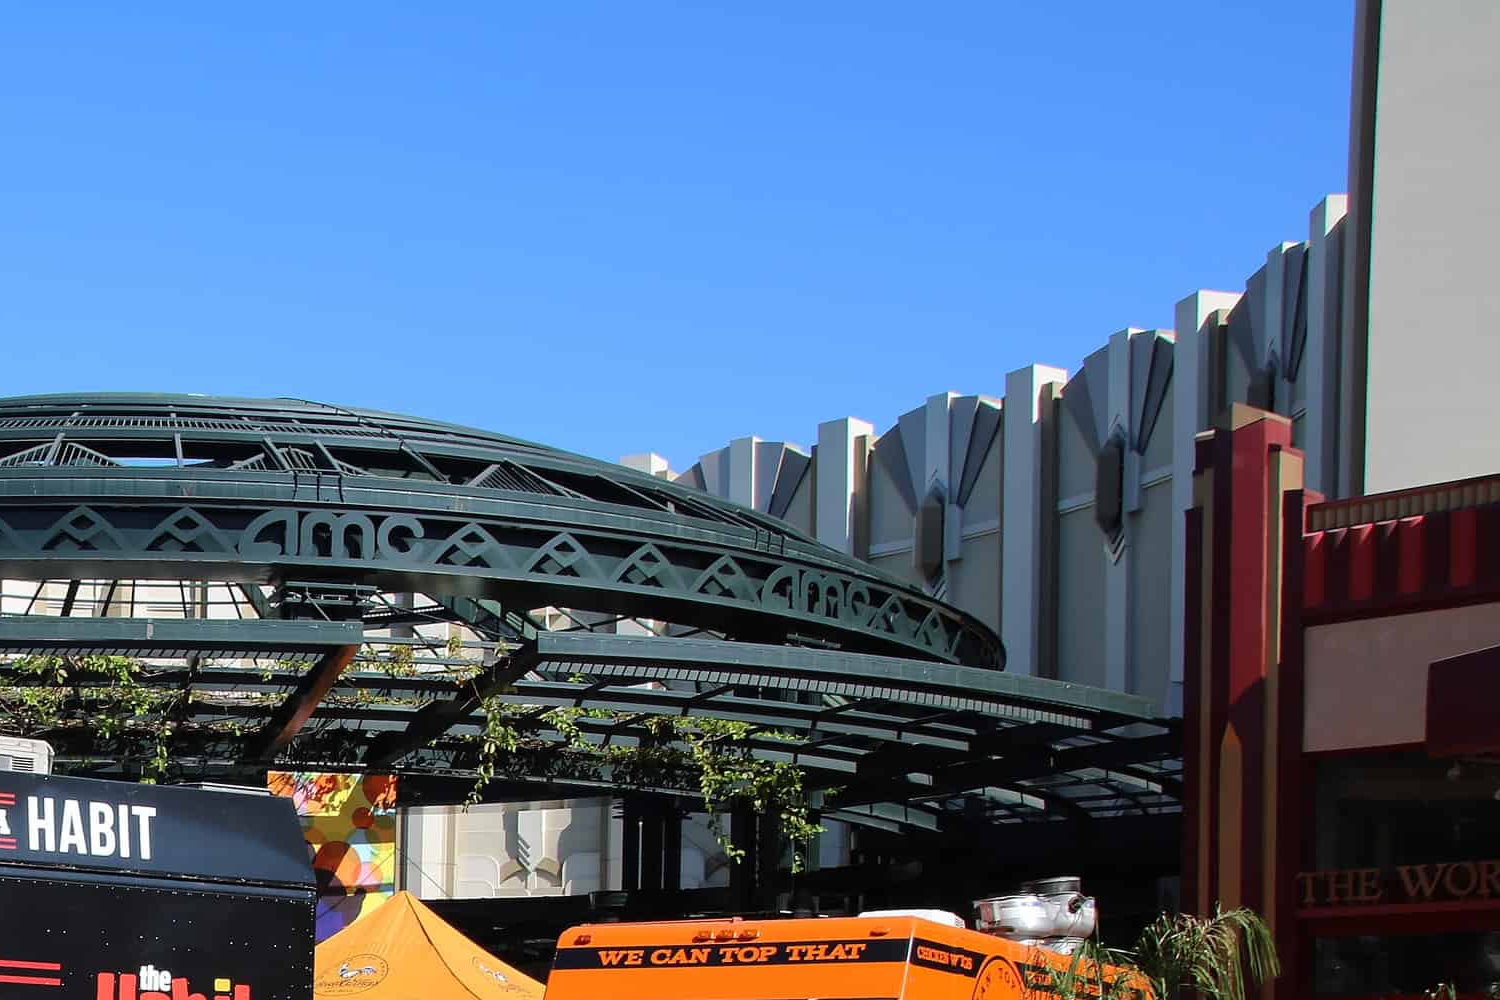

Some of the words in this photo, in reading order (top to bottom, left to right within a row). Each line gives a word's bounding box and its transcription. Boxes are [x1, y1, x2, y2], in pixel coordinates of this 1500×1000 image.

[27, 795, 157, 861] HABIT
[1294, 868, 1382, 903] THE
[598, 949, 644, 967] WE
[649, 947, 712, 966] CAN
[719, 946, 776, 964] TOP
[785, 943, 866, 961] THAT
[139, 964, 172, 992] the
